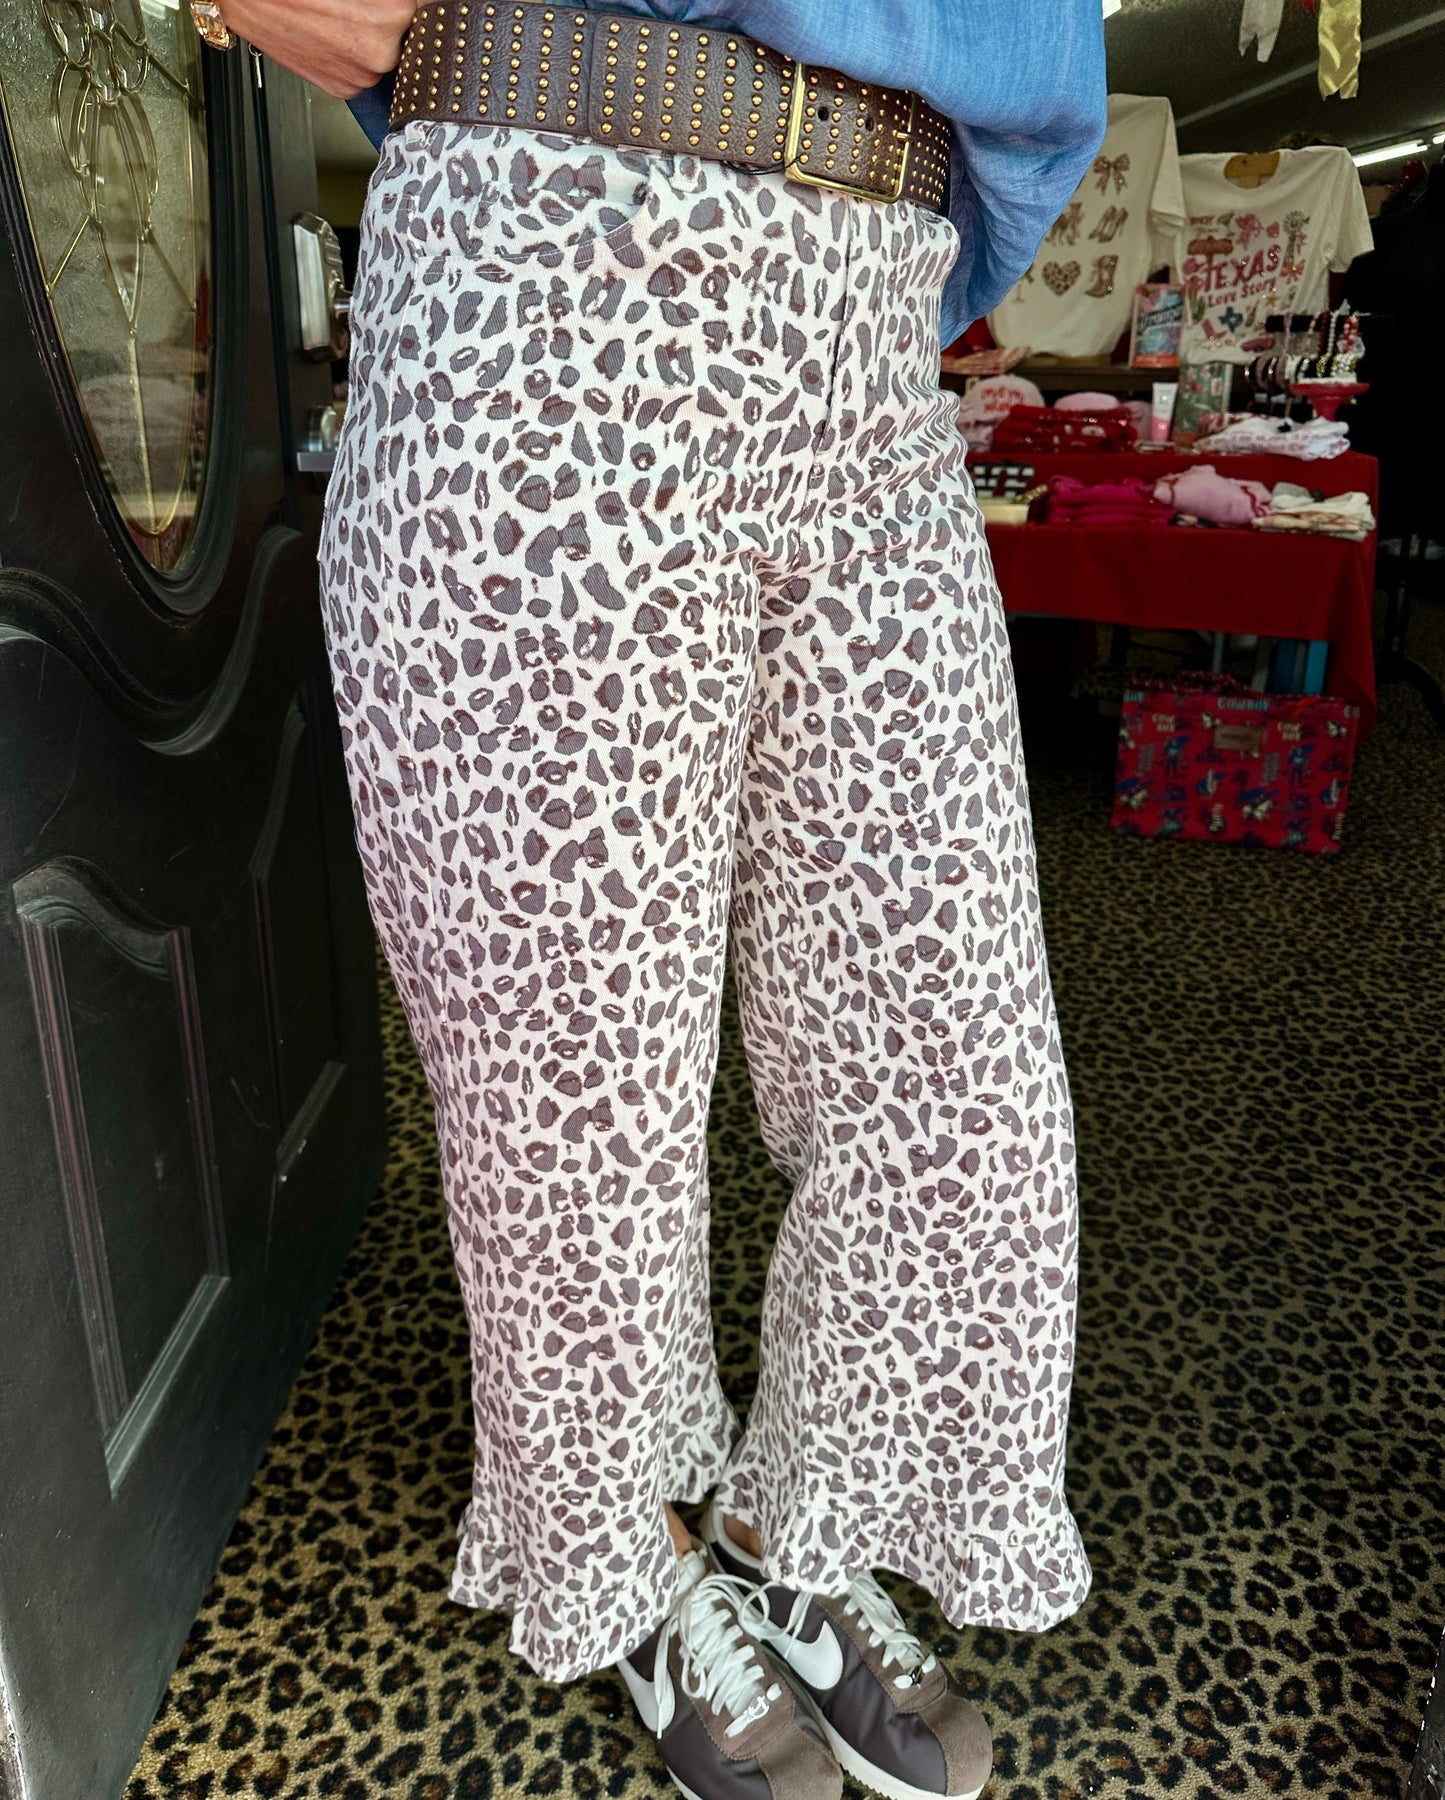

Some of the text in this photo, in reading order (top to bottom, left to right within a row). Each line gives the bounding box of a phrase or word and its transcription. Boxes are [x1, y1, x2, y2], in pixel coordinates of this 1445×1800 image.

[1203, 244, 1281, 291] TEXAS
[1208, 277, 1277, 308] Love Story
